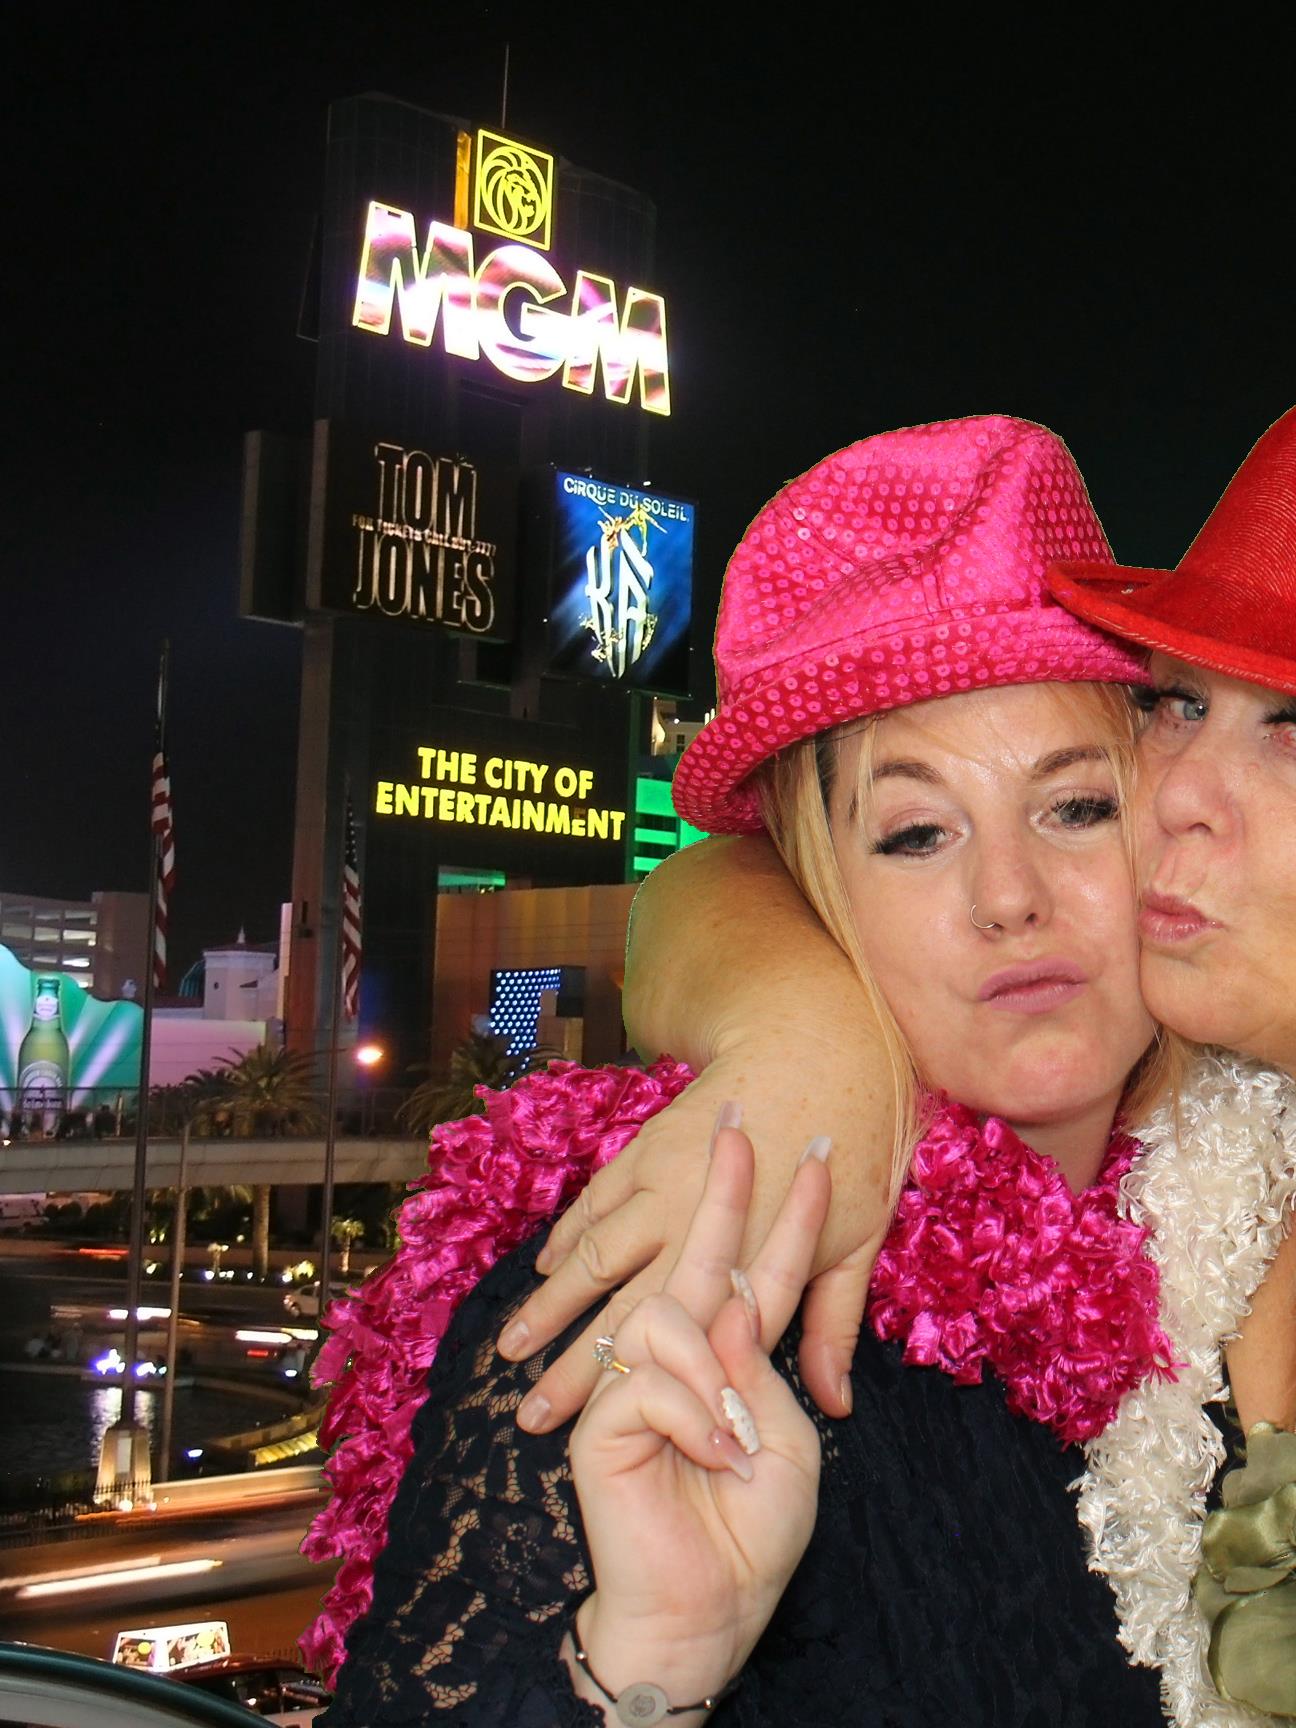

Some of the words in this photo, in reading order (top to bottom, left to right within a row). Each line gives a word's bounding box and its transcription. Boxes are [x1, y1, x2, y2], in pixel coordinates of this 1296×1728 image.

[353, 201, 670, 416] MGM
[374, 442, 477, 538] TOM
[563, 477, 616, 506] CIRQUE
[620, 492, 639, 509] DU
[641, 497, 687, 521] SOLEIL
[377, 518, 423, 541] TICKETS
[353, 531, 495, 632] JONES
[417, 746, 477, 785] THE
[484, 757, 549, 793] CITY
[554, 767, 594, 799] OF
[375, 781, 626, 840] ENTERTAINMENT
